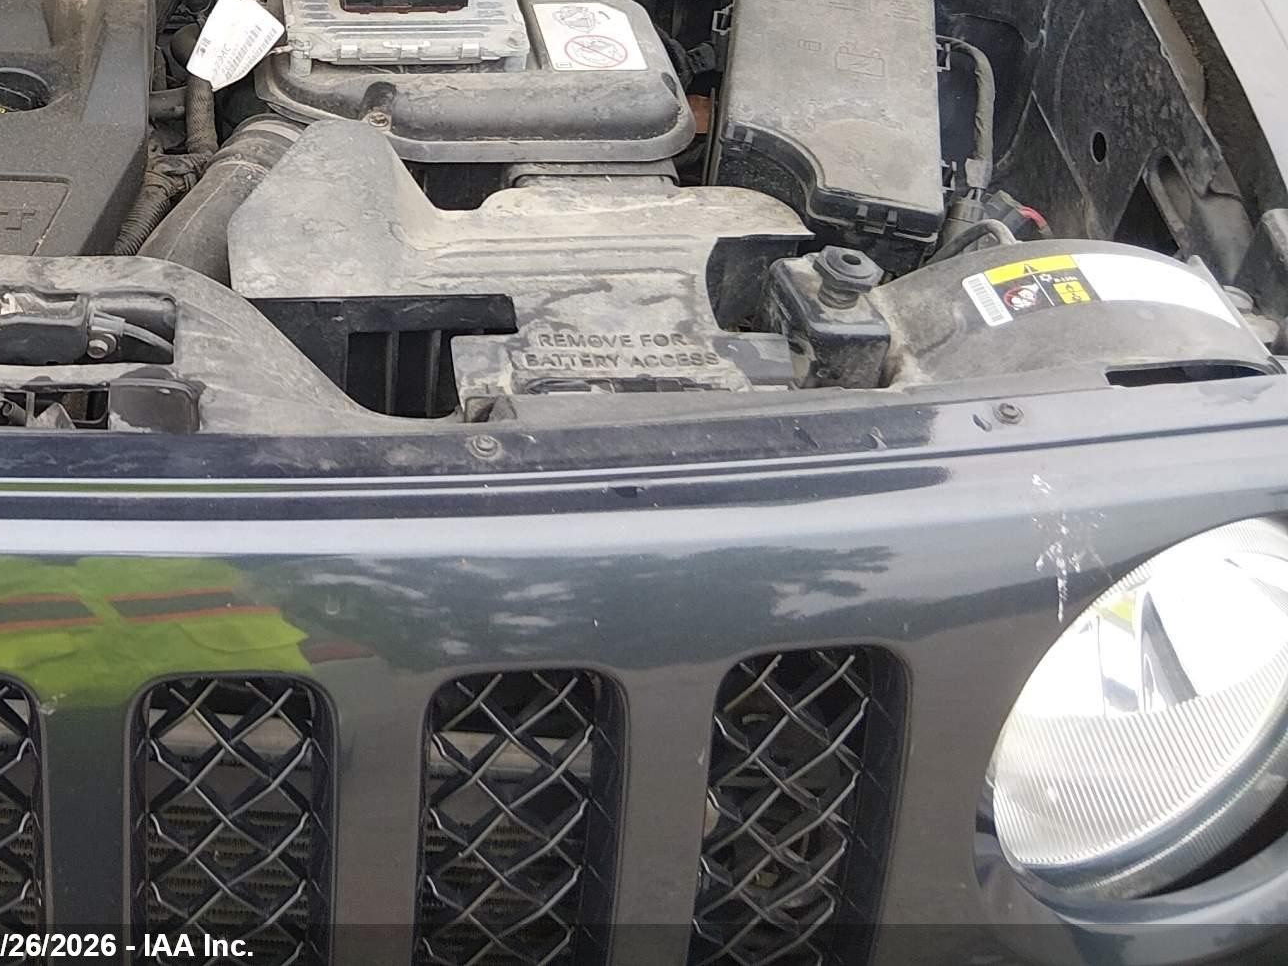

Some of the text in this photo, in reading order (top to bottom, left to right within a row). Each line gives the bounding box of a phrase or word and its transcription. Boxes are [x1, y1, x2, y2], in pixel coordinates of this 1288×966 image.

[538, 333, 688, 348] REMOVE FOR
[524, 352, 720, 368] BATTERY ACCESS
